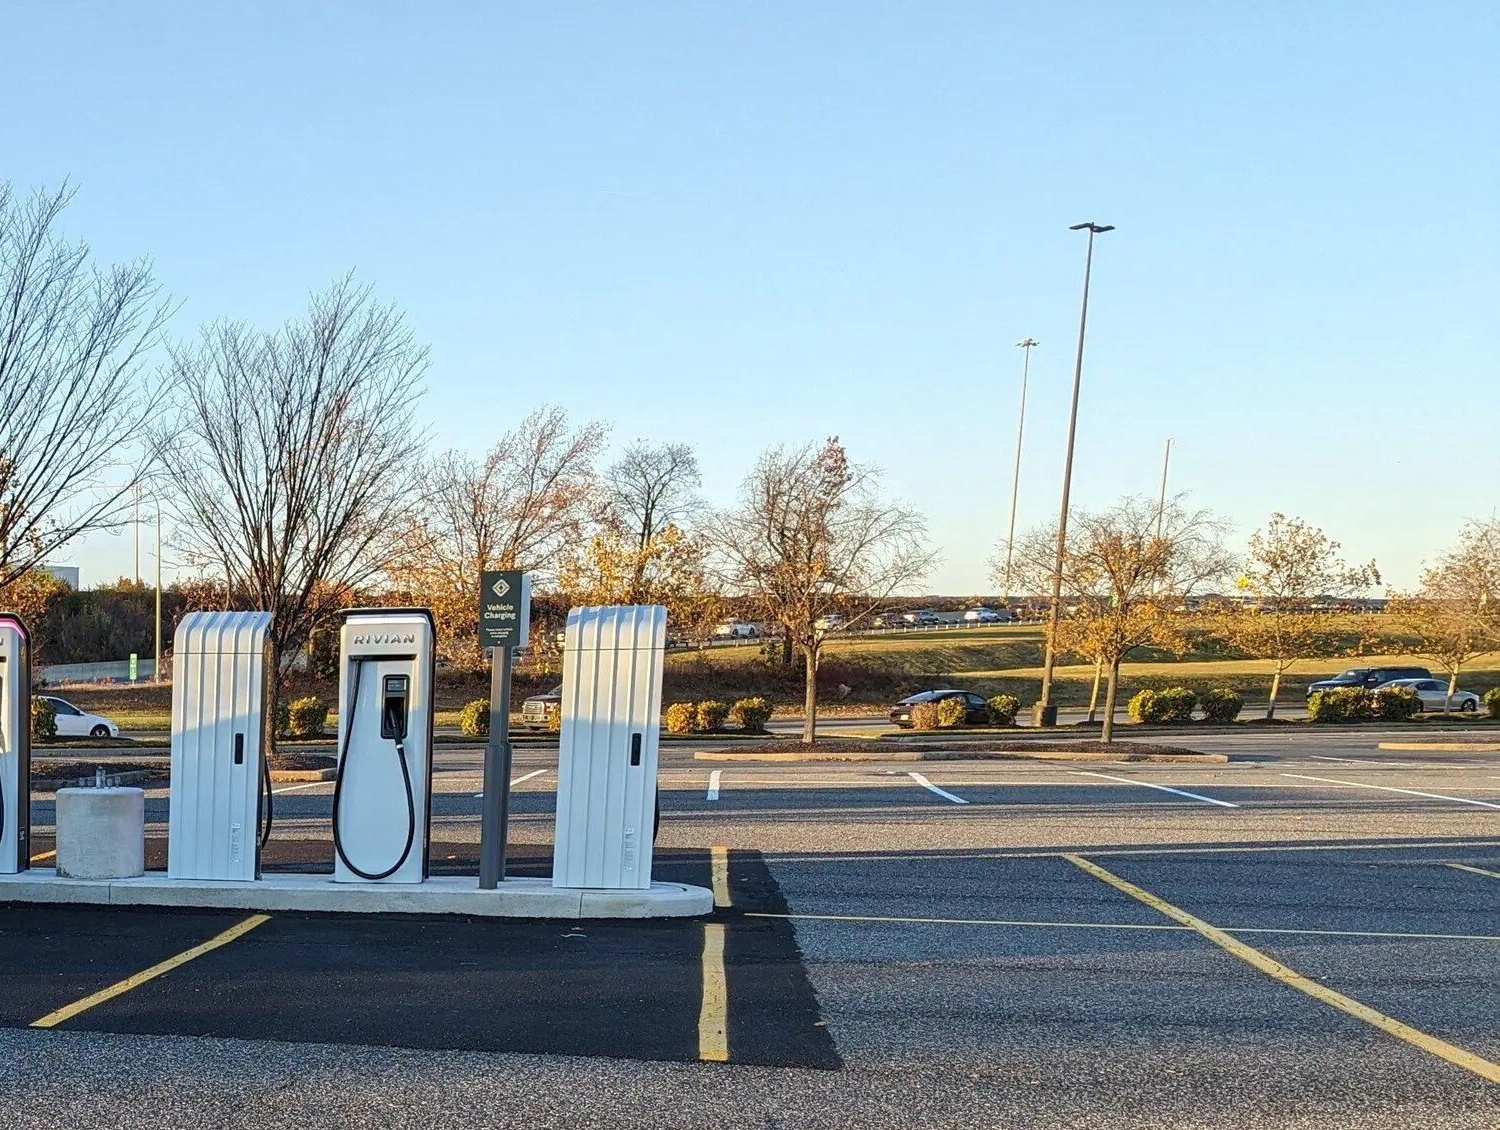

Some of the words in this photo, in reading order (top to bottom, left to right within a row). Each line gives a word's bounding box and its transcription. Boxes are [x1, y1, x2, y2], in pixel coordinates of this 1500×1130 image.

[486, 603, 514, 611] Vehicle
[484, 612, 516, 621] Charging
[354, 634, 415, 645] RIVIAN
